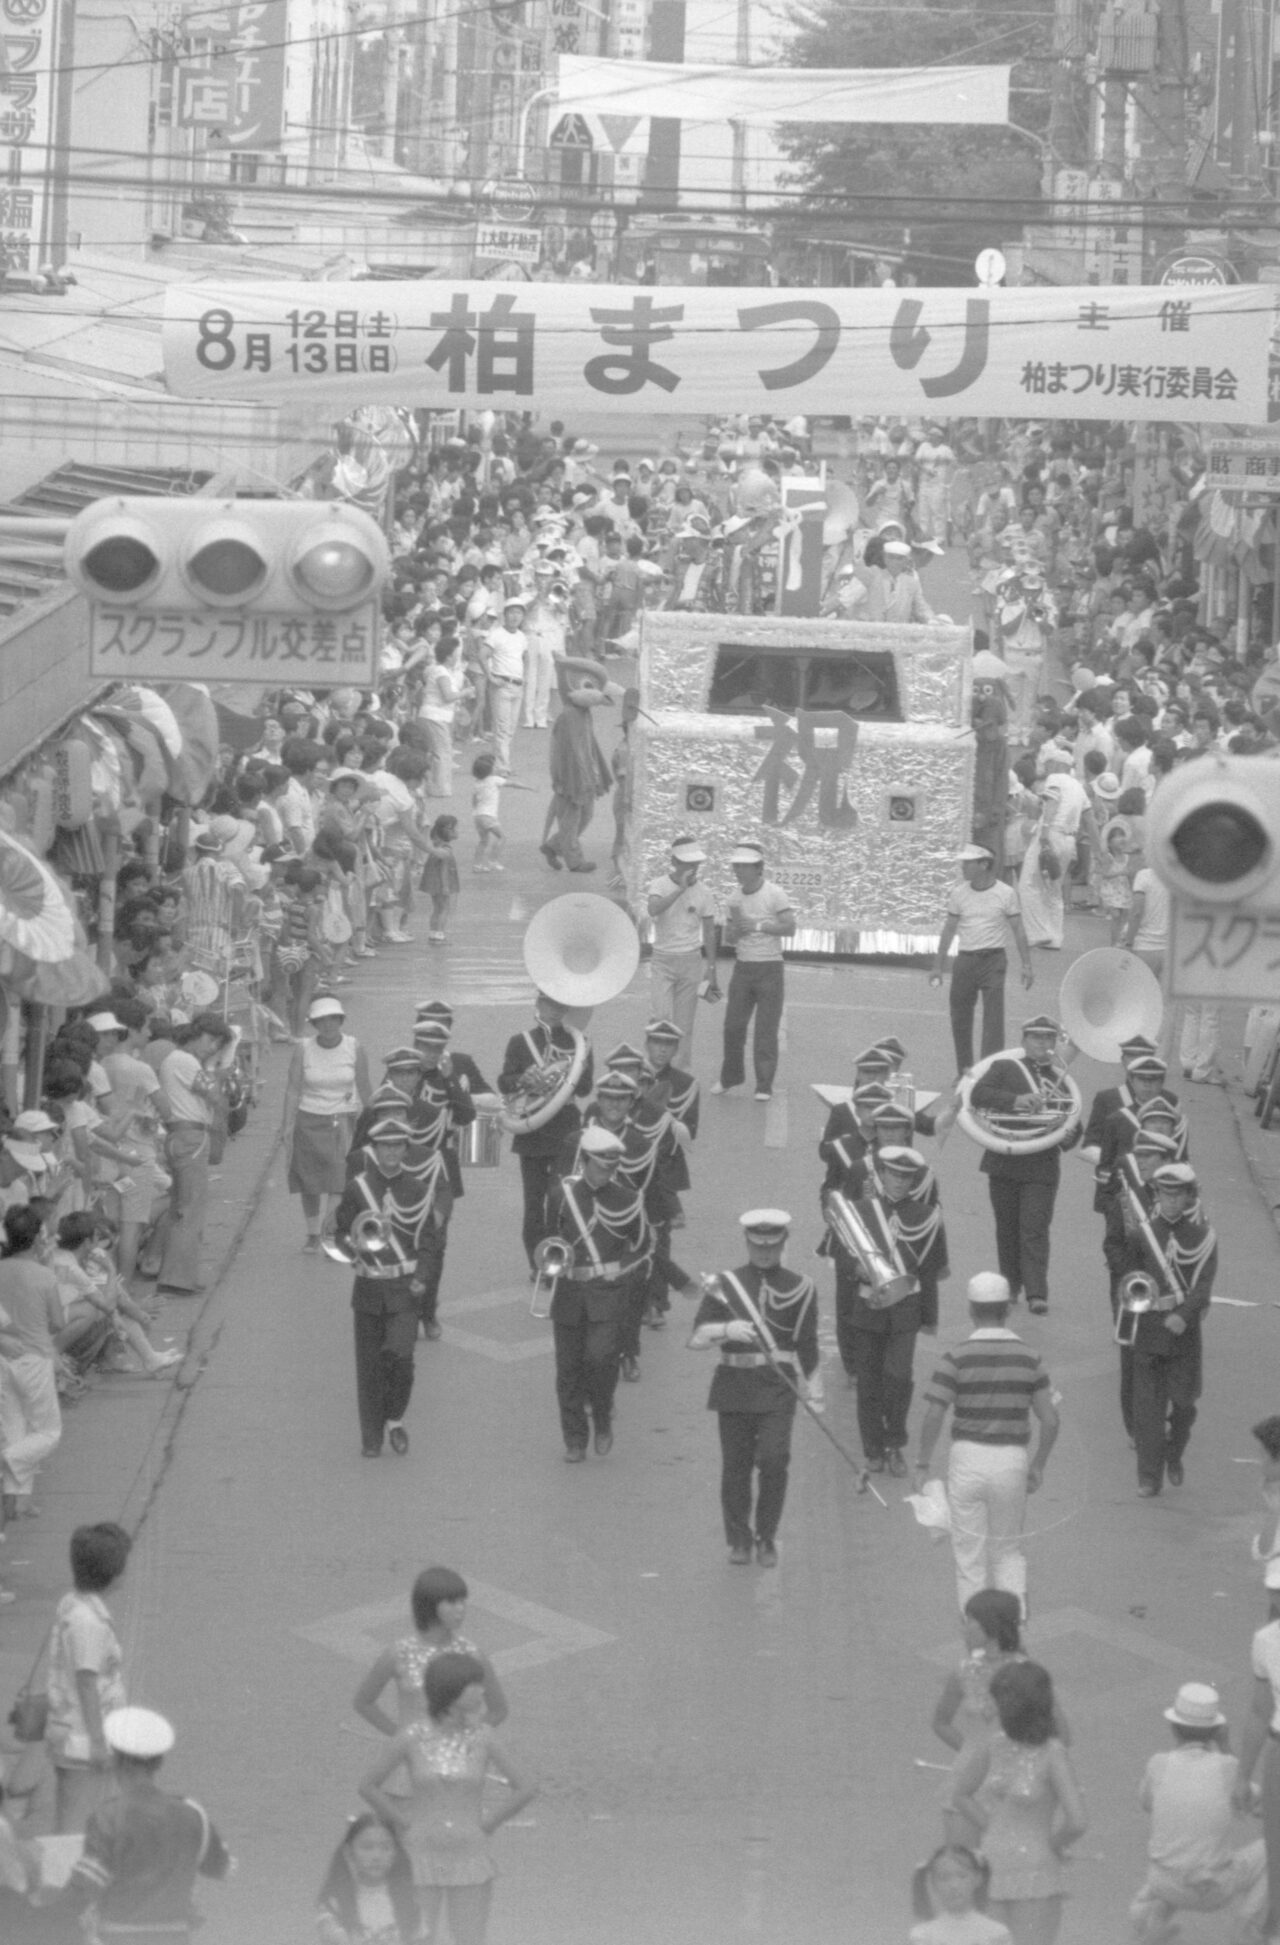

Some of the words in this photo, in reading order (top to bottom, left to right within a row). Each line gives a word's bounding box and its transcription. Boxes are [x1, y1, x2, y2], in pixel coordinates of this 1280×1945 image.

[196, 310, 272, 373] 8月
[425, 292, 990, 398] 柏まつり
[1020, 361, 1239, 401] 柏まつり実行委員会
[100, 611, 367, 663] スクランブル交差点
[752, 704, 859, 829] 祝
